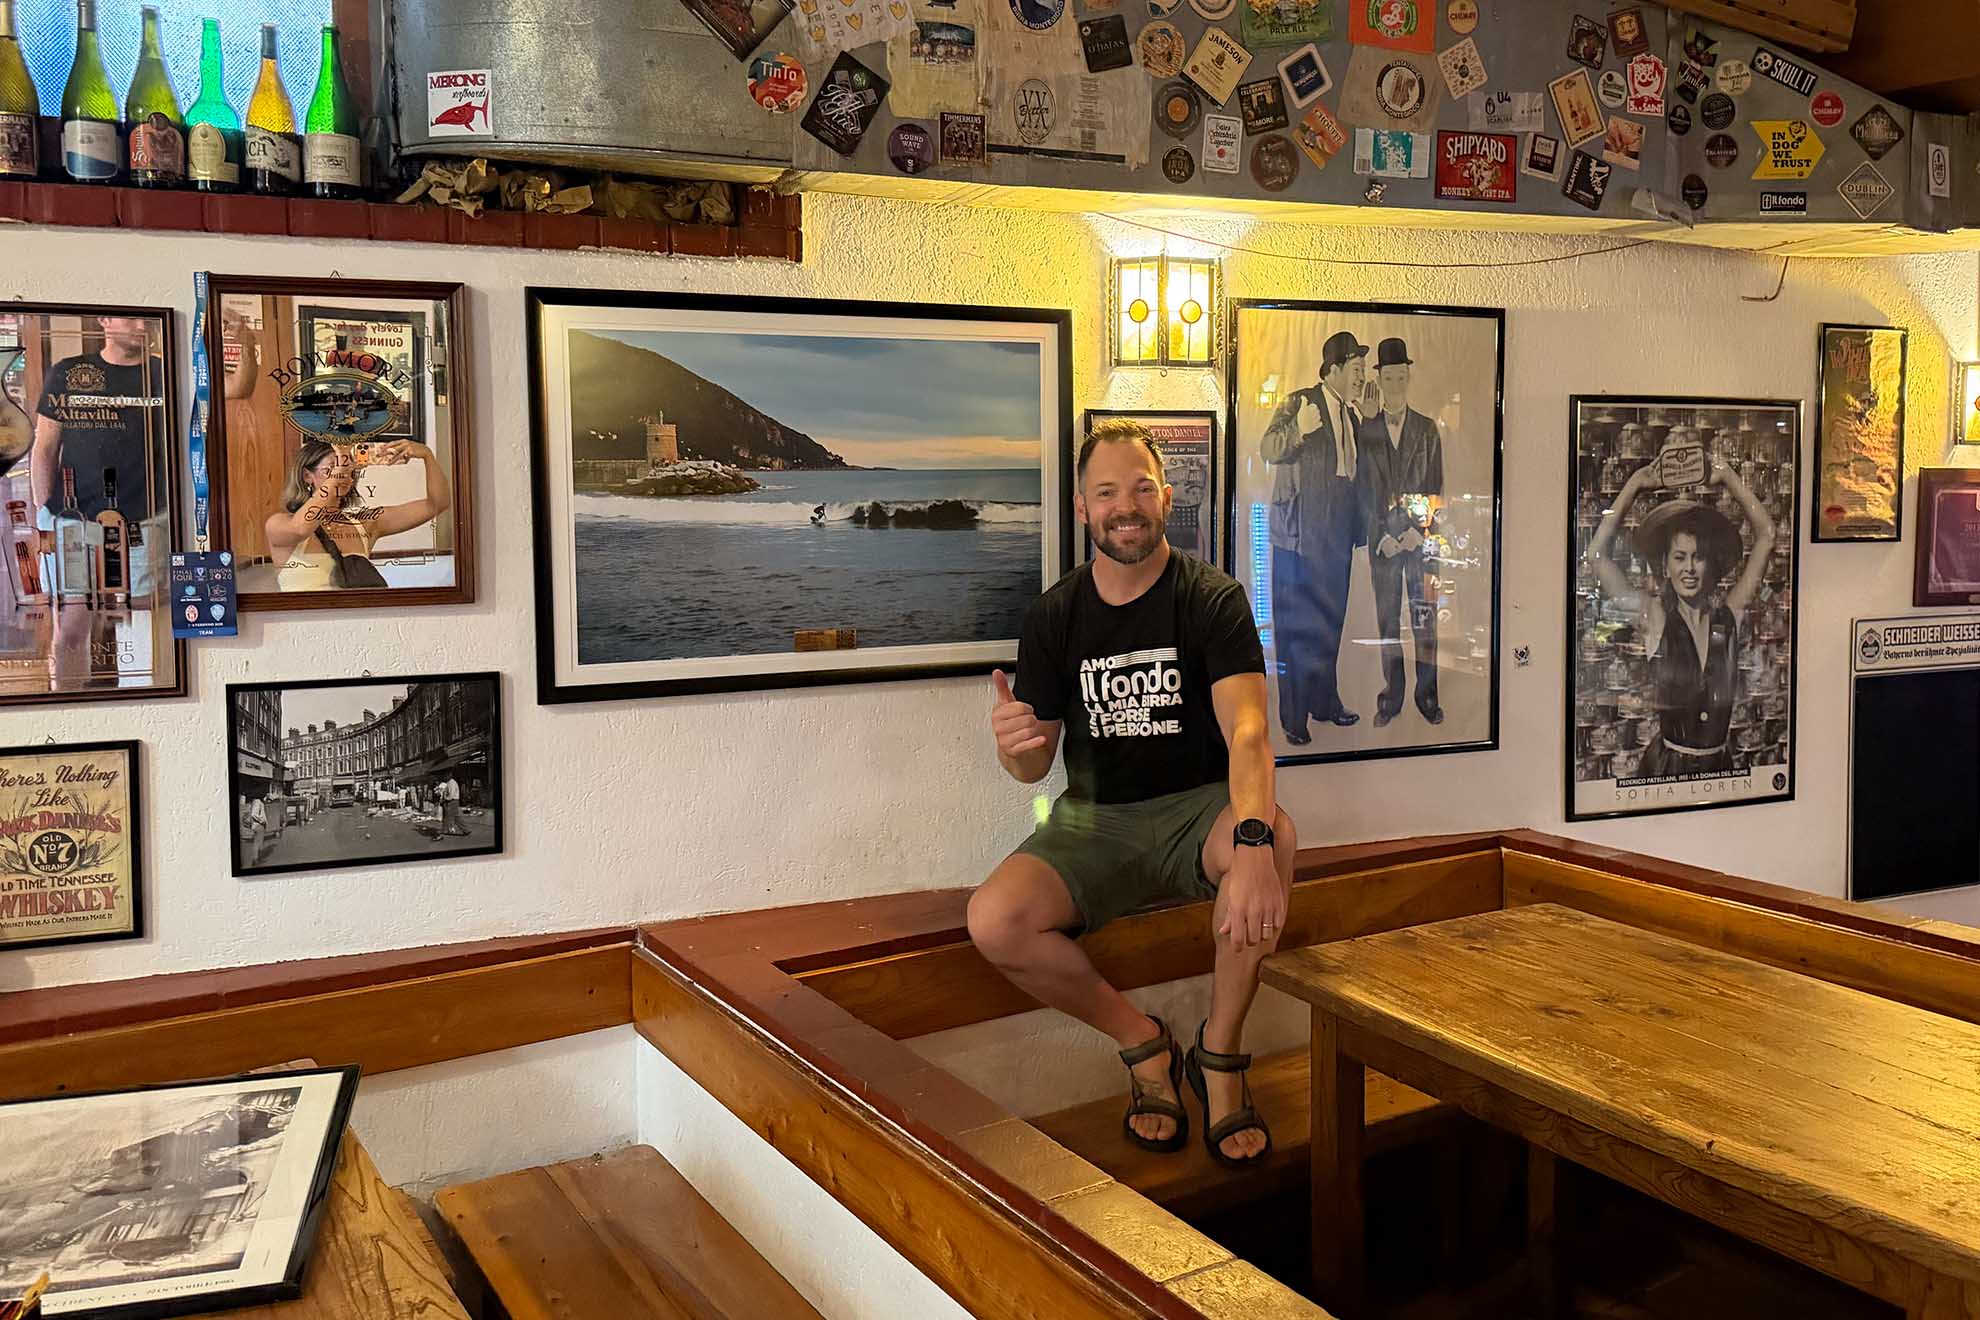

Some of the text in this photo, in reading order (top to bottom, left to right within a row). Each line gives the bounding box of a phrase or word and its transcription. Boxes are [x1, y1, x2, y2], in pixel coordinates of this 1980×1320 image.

[1208, 34, 1243, 65] JAMESON
[430, 73, 486, 90] MEKONG
[1770, 58, 1816, 94] SKULL IT
[1018, 104, 1049, 117] Bitter
[1772, 132, 1786, 140] IN
[1446, 134, 1507, 163] SHIPYARD
[1772, 141, 1800, 150] DOG
[1772, 150, 1792, 159] WE
[1772, 159, 1812, 168] TRUST
[1847, 184, 1886, 194] DUBLIN
[268, 350, 411, 391] BOWMORE
[335, 454, 349, 467] 12
[1884, 624, 1980, 646] SCHNEIDER WEISSE
[1080, 656, 1118, 673] AMO
[1101, 661, 1182, 702] fondo
[1108, 695, 1140, 712] MIA
[1141, 692, 1183, 708] BIRRA
[1100, 707, 1151, 726] FORSE
[55, 763, 120, 789] Nothing
[1619, 778, 1647, 787] FEDERICO
[30, 787, 71, 809] Like
[1616, 778, 1752, 801] SOFIA LOREN
[42, 834, 62, 843] OLD
[39, 861, 68, 873] BRAND
[1, 872, 117, 892] LD TIME TENNESSEE
